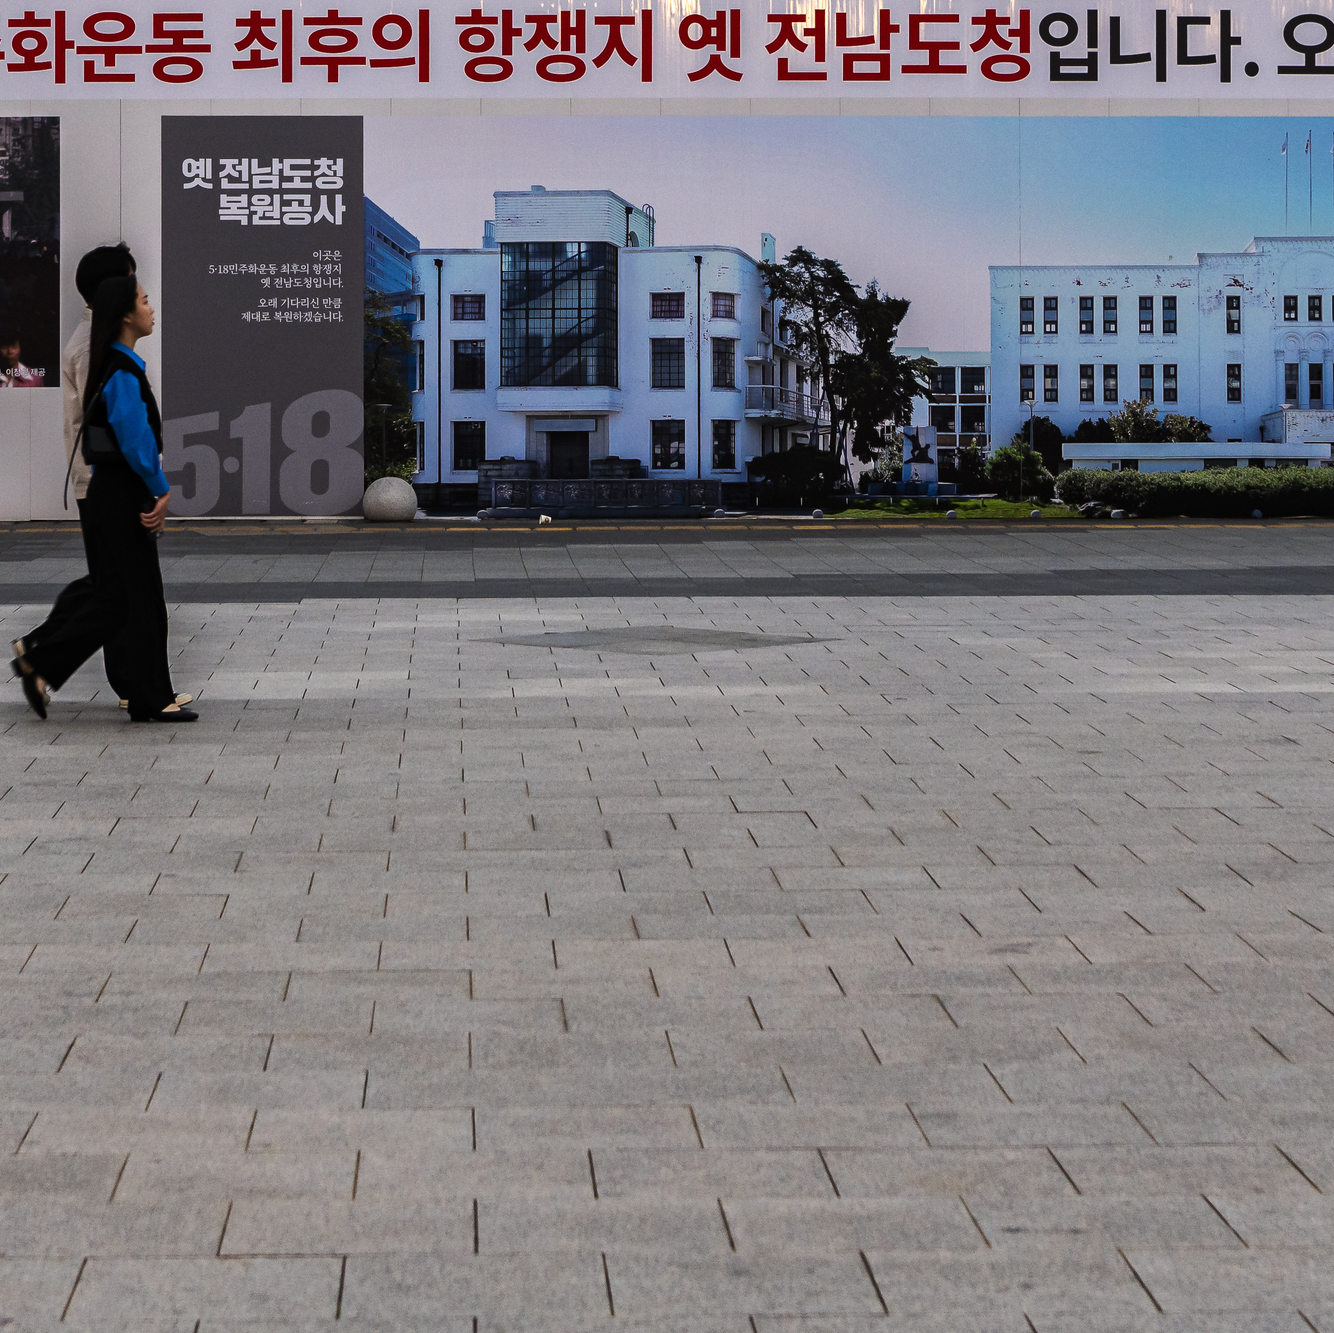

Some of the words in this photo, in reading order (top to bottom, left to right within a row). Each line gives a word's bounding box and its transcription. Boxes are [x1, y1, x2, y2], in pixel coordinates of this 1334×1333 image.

[232, 9, 430, 83] 최후의
[454, 8, 653, 83] 항쟁지
[678, 8, 743, 82] 옛
[765, 8, 1260, 83] 전남도청입니다.
[182, 158, 213, 189] 옛
[219, 157, 344, 189] 전남도청
[219, 194, 346, 226] 복원공사
[312, 249, 343, 262] 이곳은
[208, 263, 279, 275] 5·18민주화운동
[280, 263, 310, 275] 최후의
[312, 263, 342, 275] 항쟁지
[260, 276, 271, 288] 옛
[273, 276, 344, 289] 전남도청입니다.
[258, 297, 278, 309] 오래
[280, 297, 320, 309] 기다리신
[322, 297, 343, 309] 만큼
[241, 310, 271, 323] 제대로
[273, 310, 344, 323] 복원하겠습니다.
